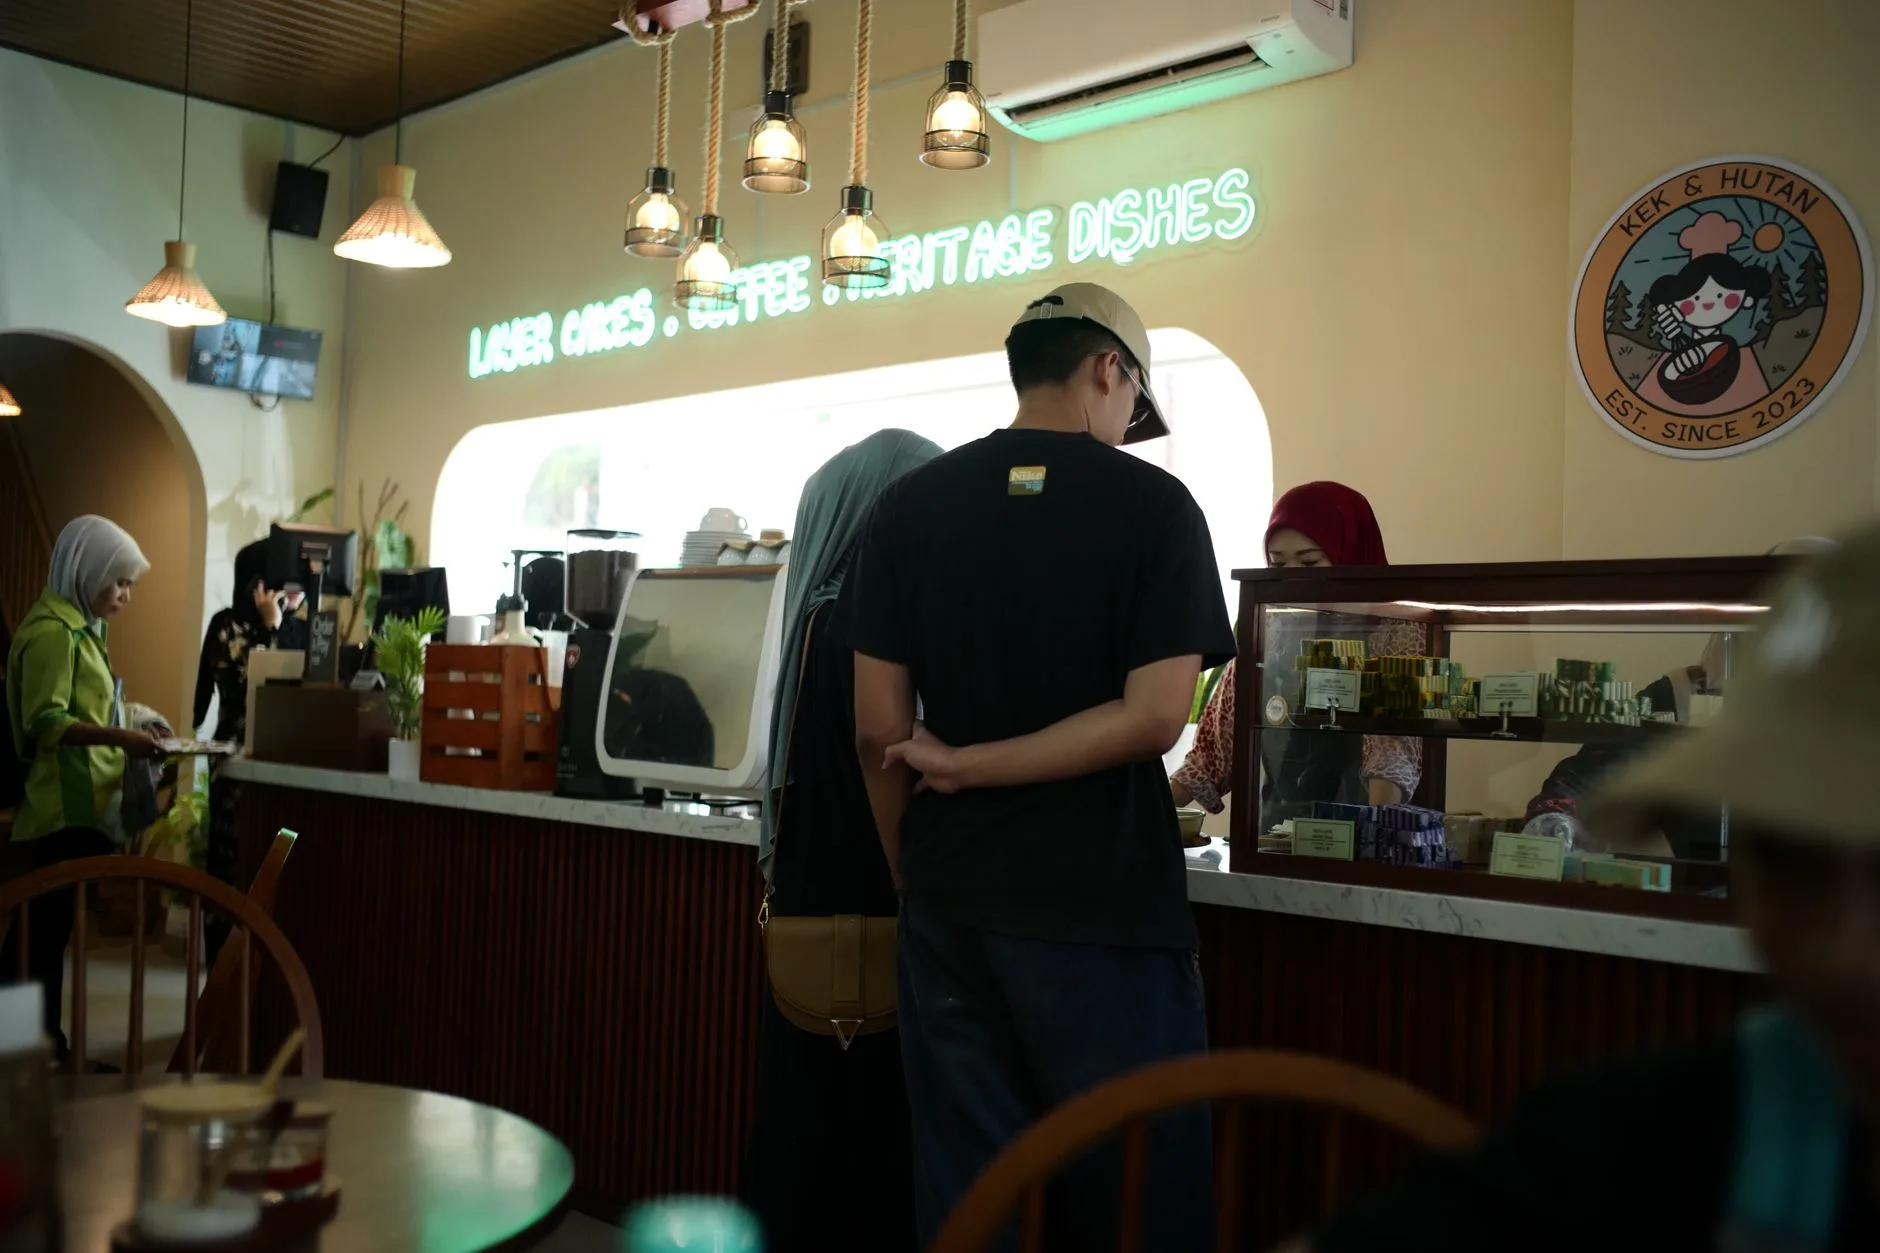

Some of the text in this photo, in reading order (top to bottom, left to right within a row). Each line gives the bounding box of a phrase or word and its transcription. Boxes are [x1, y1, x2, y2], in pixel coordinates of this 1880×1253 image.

[1618, 167, 1820, 238] KEK & HUTAN
[560, 287, 656, 357] CAKES
[1067, 167, 1256, 266] DISHES
[1604, 377, 1816, 442] EST. SINCE 2023
